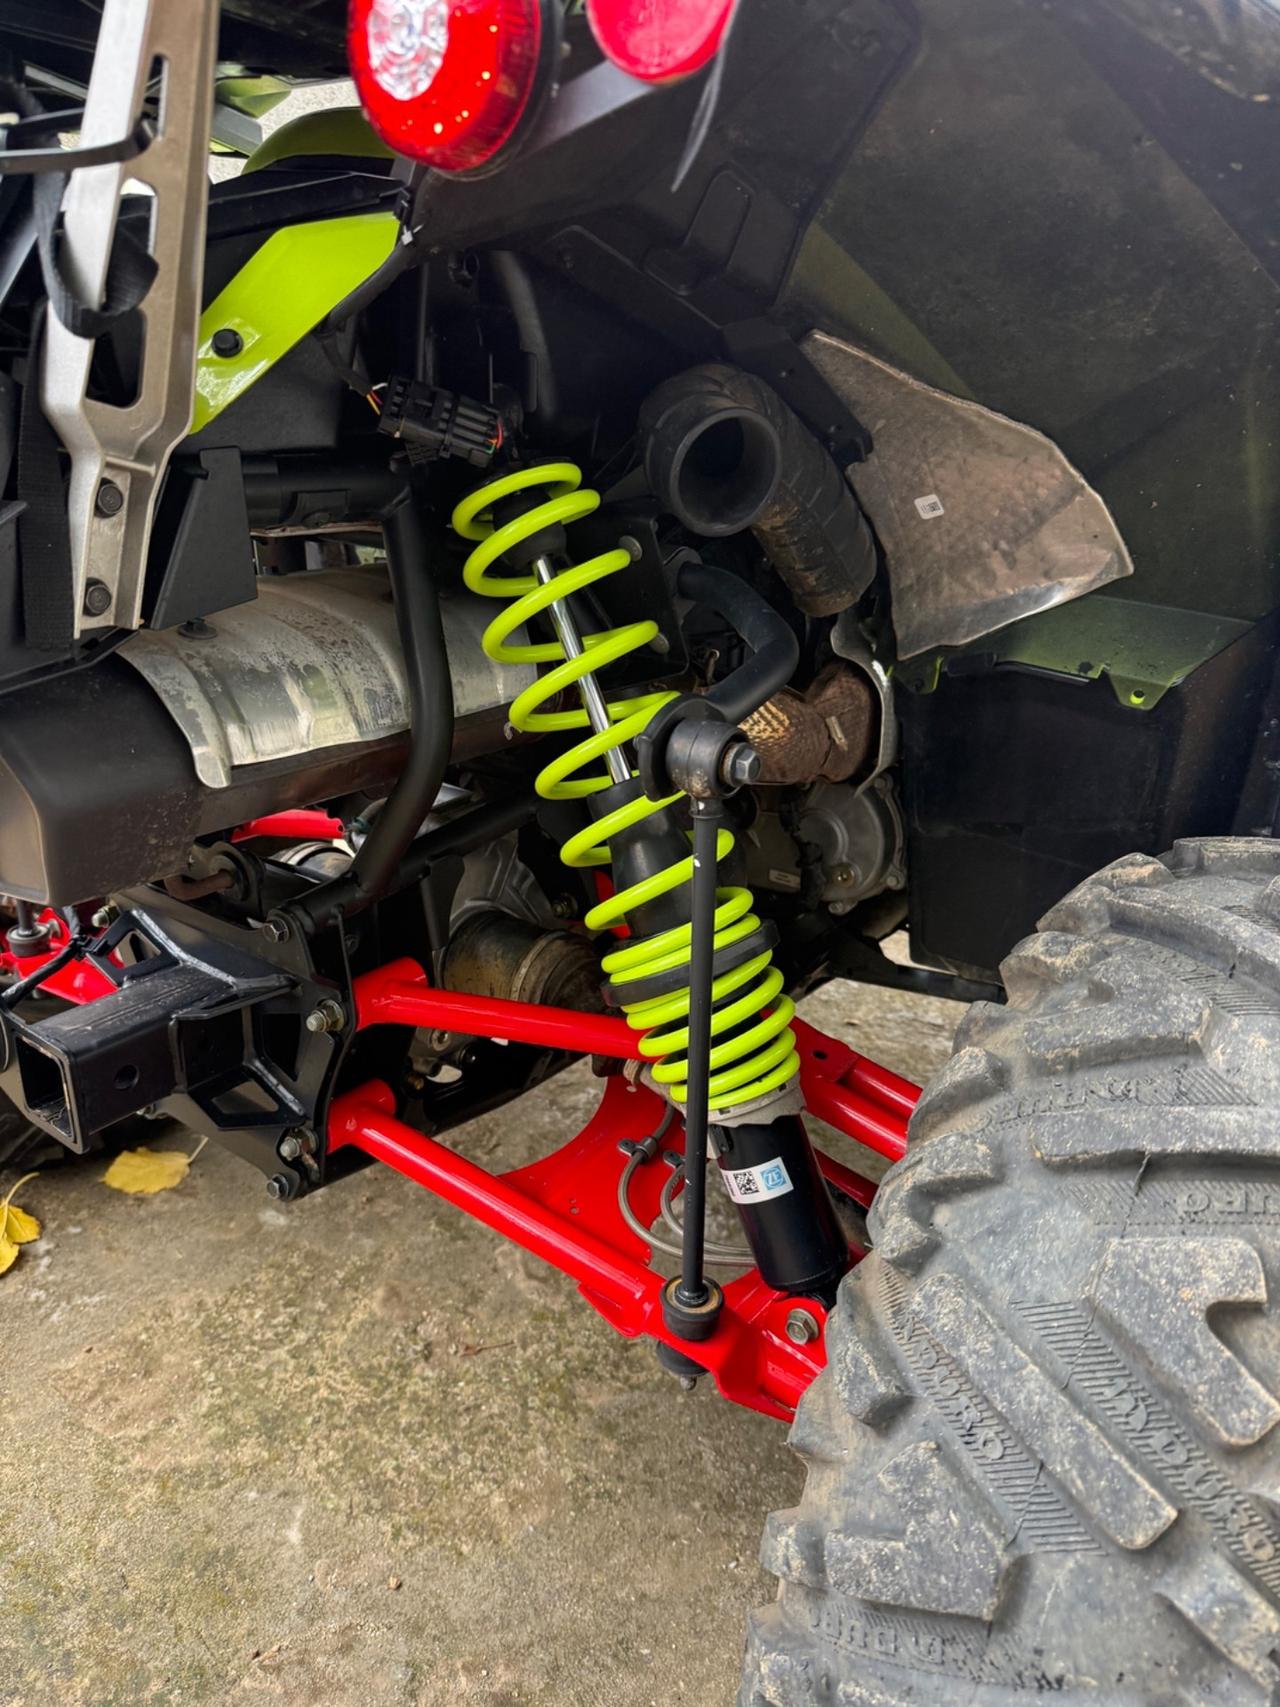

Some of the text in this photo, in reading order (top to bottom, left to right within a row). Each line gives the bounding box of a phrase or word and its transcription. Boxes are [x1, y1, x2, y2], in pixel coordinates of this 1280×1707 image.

[1187, 1190, 1280, 1215] URO
[916, 1341, 1006, 1461] DURO
[1151, 1426, 1278, 1563] DURO
